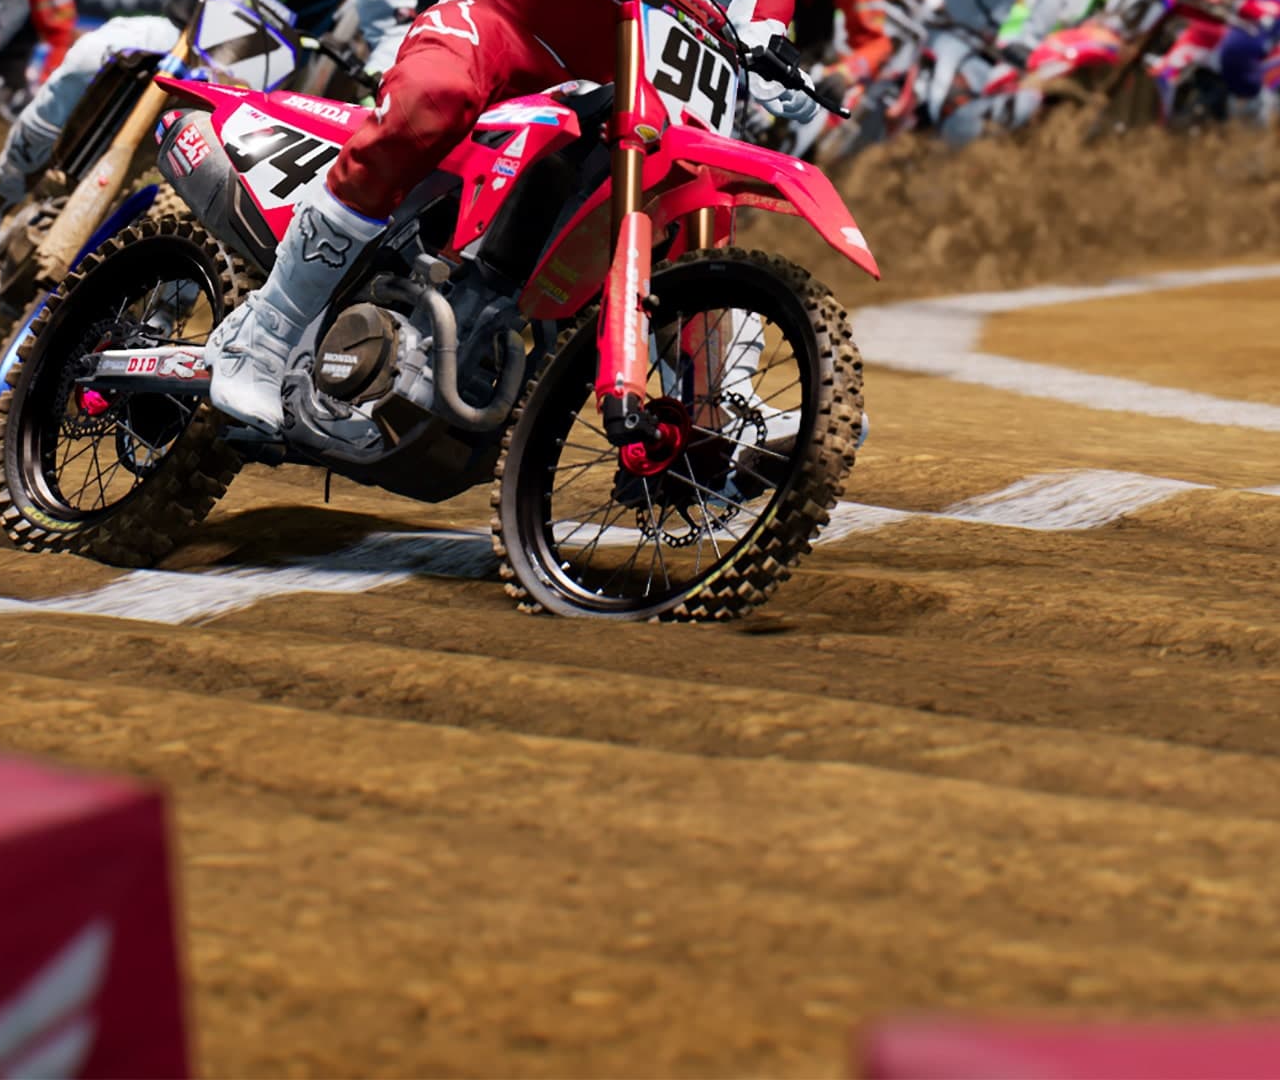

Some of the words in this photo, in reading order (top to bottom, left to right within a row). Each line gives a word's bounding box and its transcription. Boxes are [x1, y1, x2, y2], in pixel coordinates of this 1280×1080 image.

[652, 26, 732, 131] 94
[282, 95, 351, 125] HONDA
[126, 357, 158, 373] DID
